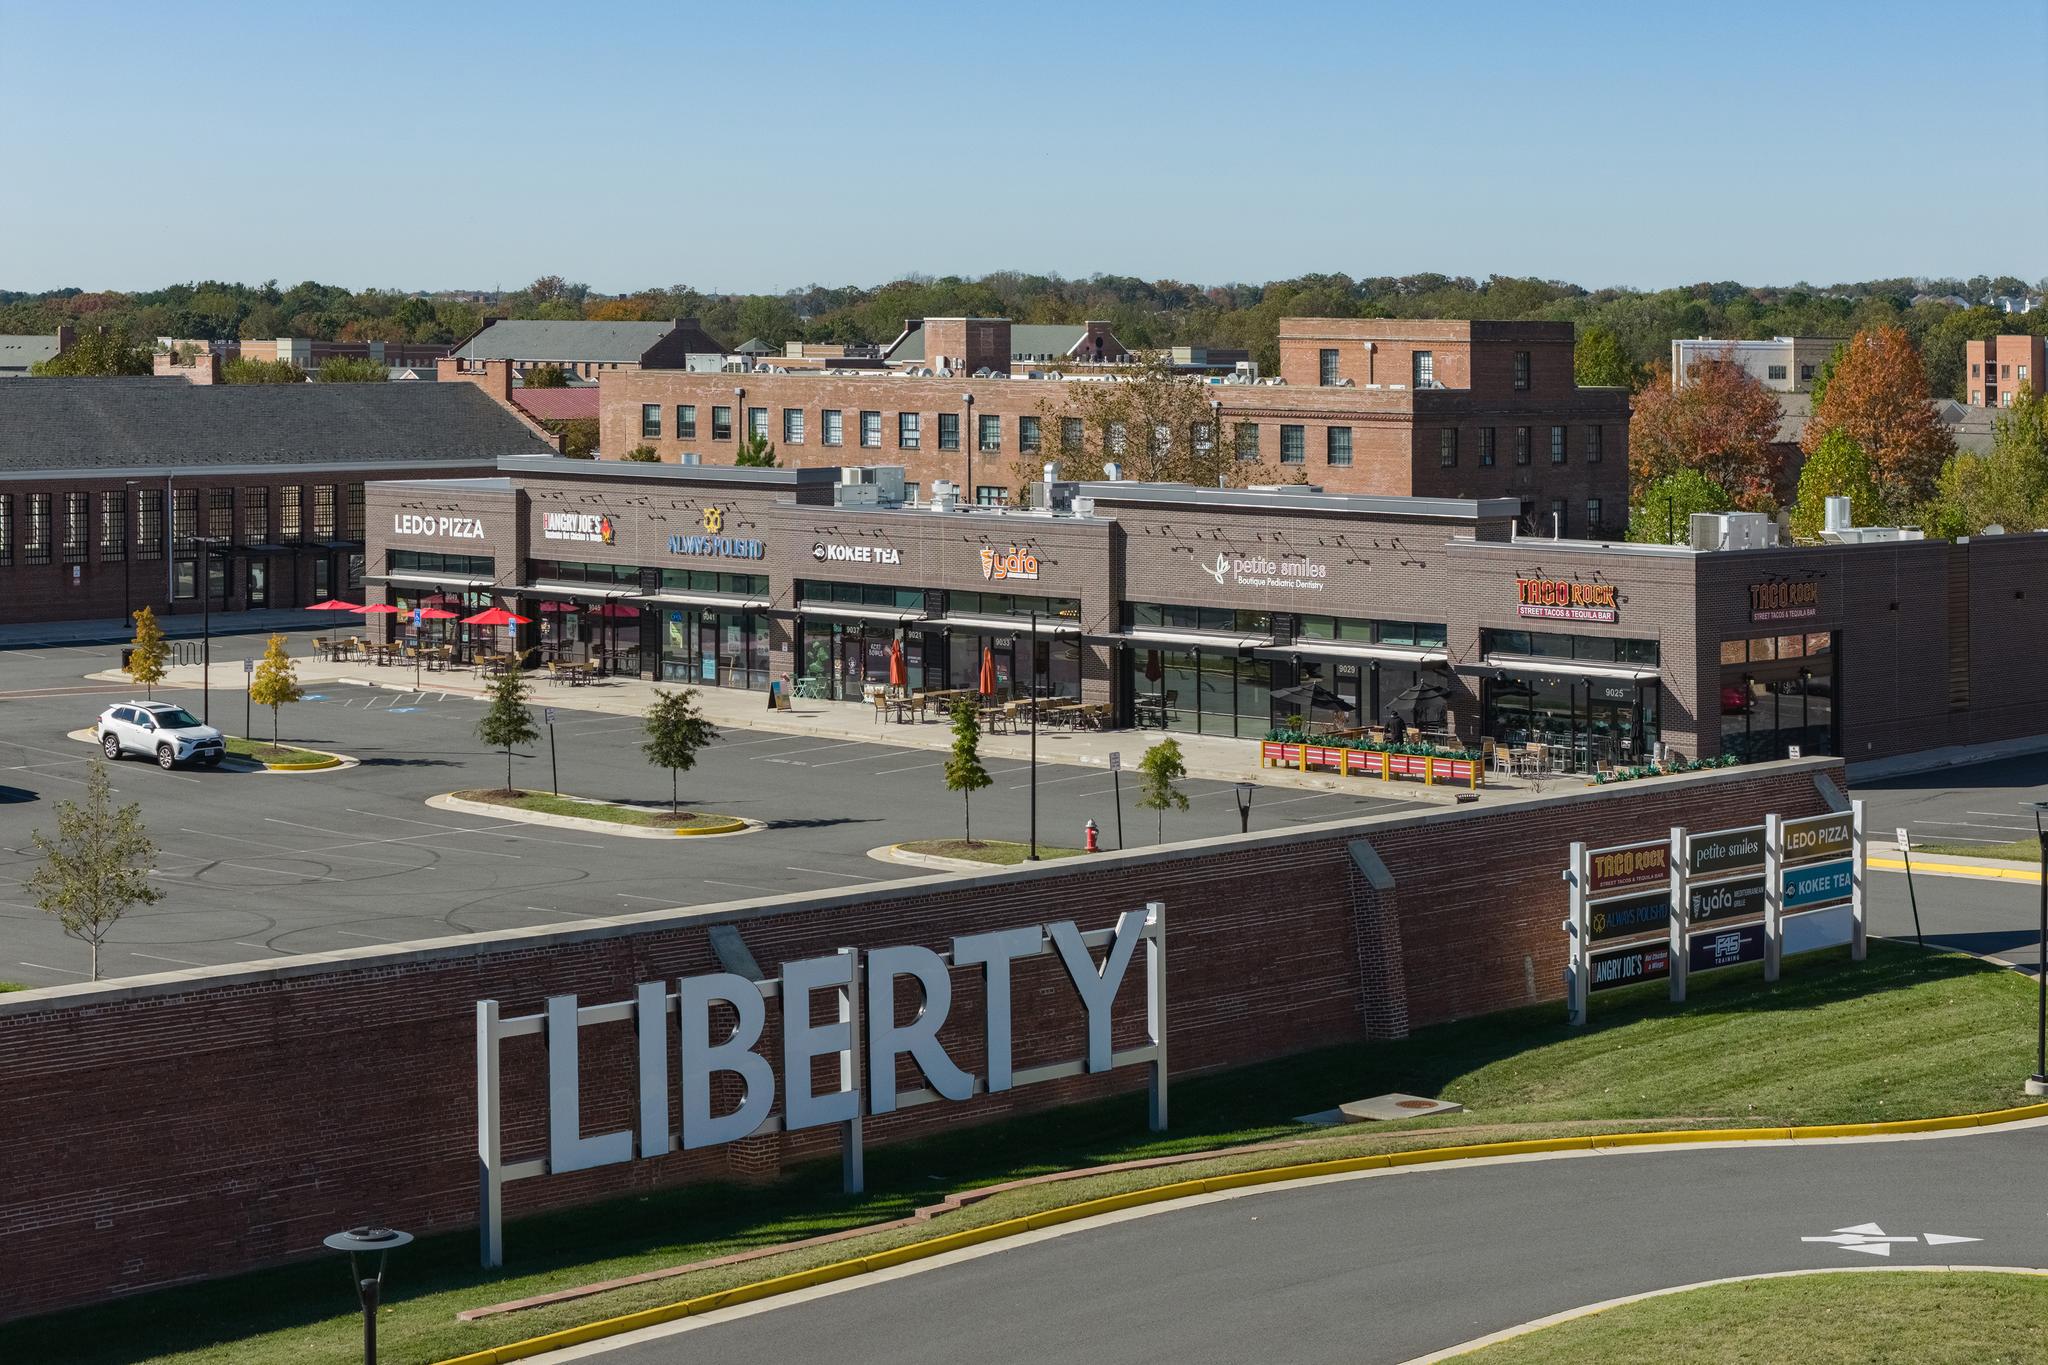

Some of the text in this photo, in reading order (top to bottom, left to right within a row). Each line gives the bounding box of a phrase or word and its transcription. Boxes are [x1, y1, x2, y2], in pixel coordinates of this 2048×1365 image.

[394, 514, 485, 539] LEDO PIZZA
[827, 545, 900, 564] KOKEE TEA
[1233, 556, 1327, 580] petite smiles
[1238, 575, 1324, 591] Boutique Pediatric Dentistry
[1516, 578, 1616, 608] TACO ROCK
[1750, 582, 1818, 609] TACO ROCK
[1519, 606, 1544, 616] STREET
[1544, 608, 1565, 617] TACOS
[1571, 611, 1598, 619] TEQUILA
[1598, 612, 1612, 620] BAR
[1338, 664, 1356, 674] 9029
[1605, 688, 1624, 698] 9025
[1787, 825, 1849, 850] LEDO PIZZA
[1594, 849, 1666, 878] TACO ROCK
[1696, 837, 1759, 868] petite smiles
[1798, 872, 1852, 895] KOKEE TEA
[1606, 911, 1635, 928] ALWAYS
[1622, 954, 1643, 978] JOE'S
[545, 908, 1149, 1175] LIBERTY
